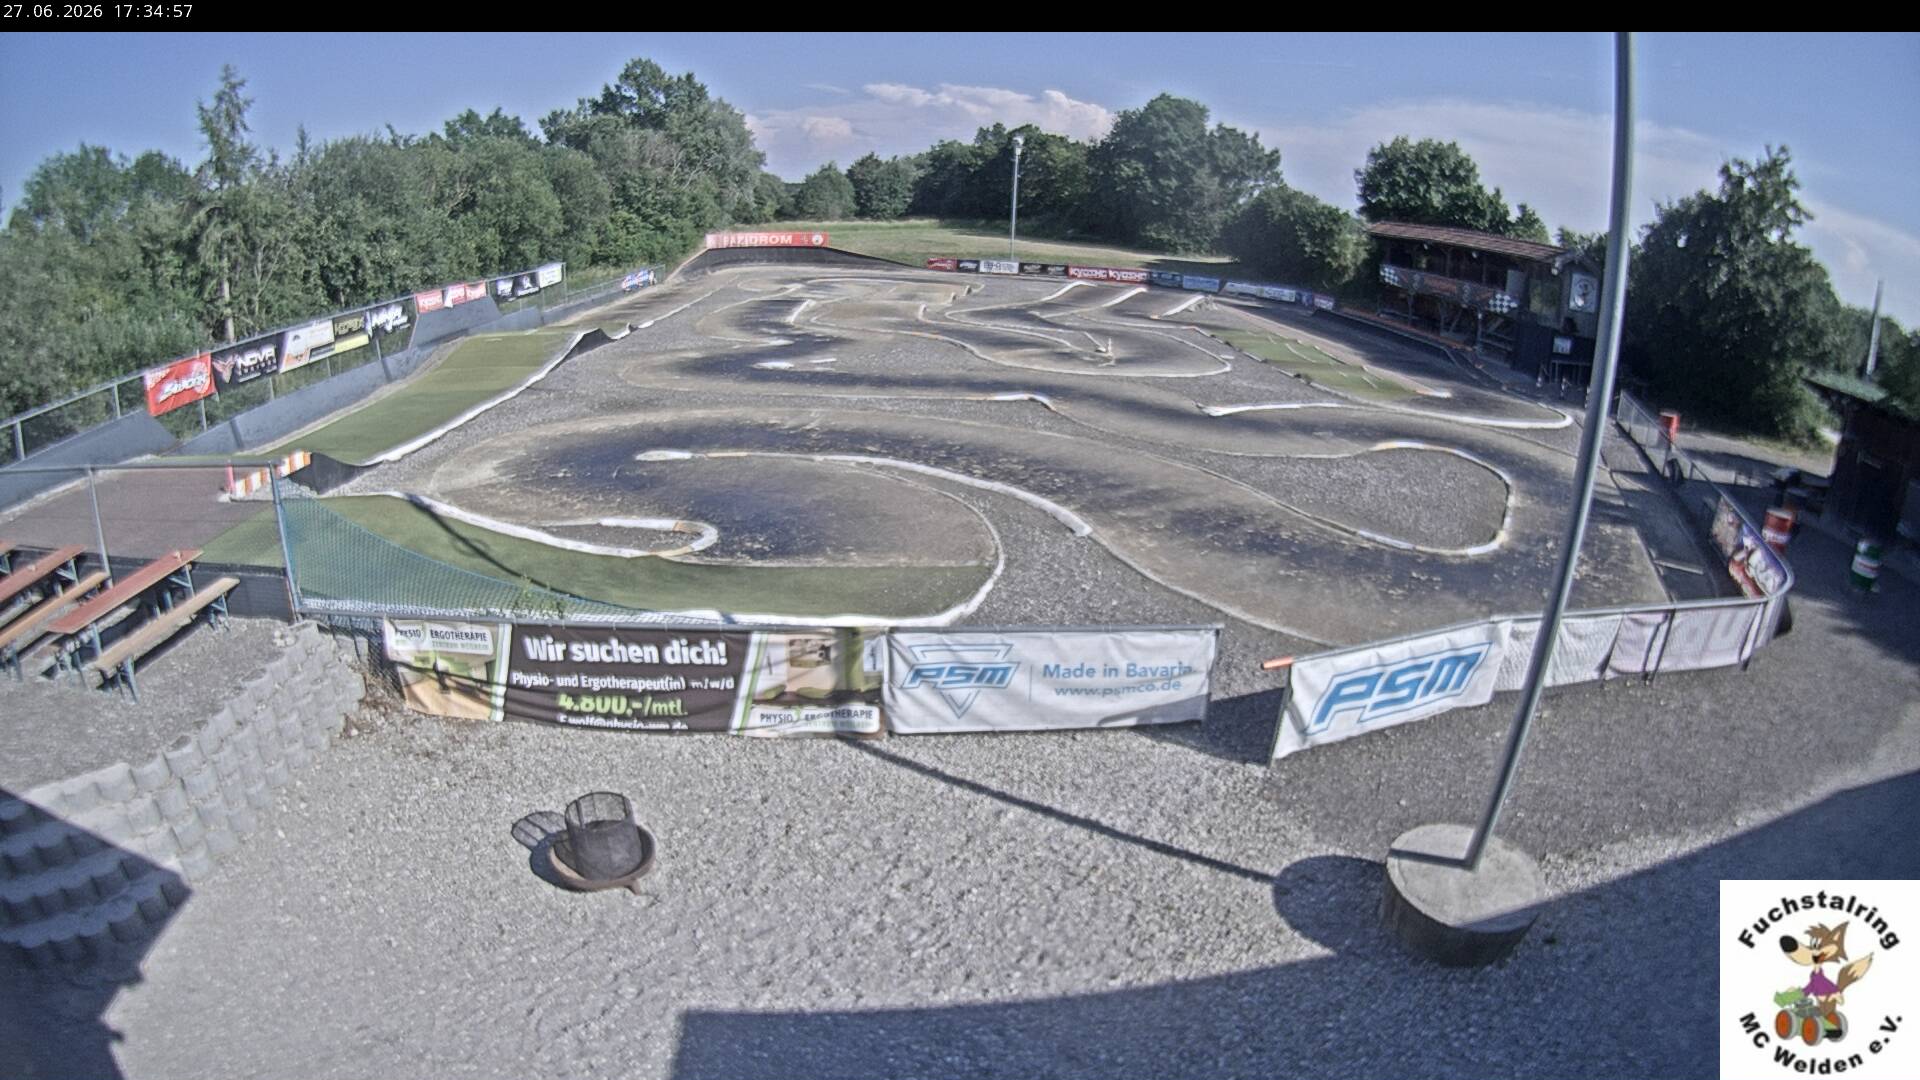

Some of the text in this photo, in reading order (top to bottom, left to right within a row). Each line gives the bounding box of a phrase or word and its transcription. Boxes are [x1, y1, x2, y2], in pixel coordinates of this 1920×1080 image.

[430, 629, 488, 642] ERGOTHERAPIE
[525, 636, 728, 666] Wir suchen dich!
[908, 665, 1014, 686] PSM
[1042, 661, 1193, 679] Made in Bavaria
[512, 671, 735, 693] Physio- und Ergotherapeut(in) m/w/d
[1054, 679, 1182, 697] www.psmco.de
[1313, 652, 1483, 726] PSM
[760, 712, 794, 724] PHYSIO
